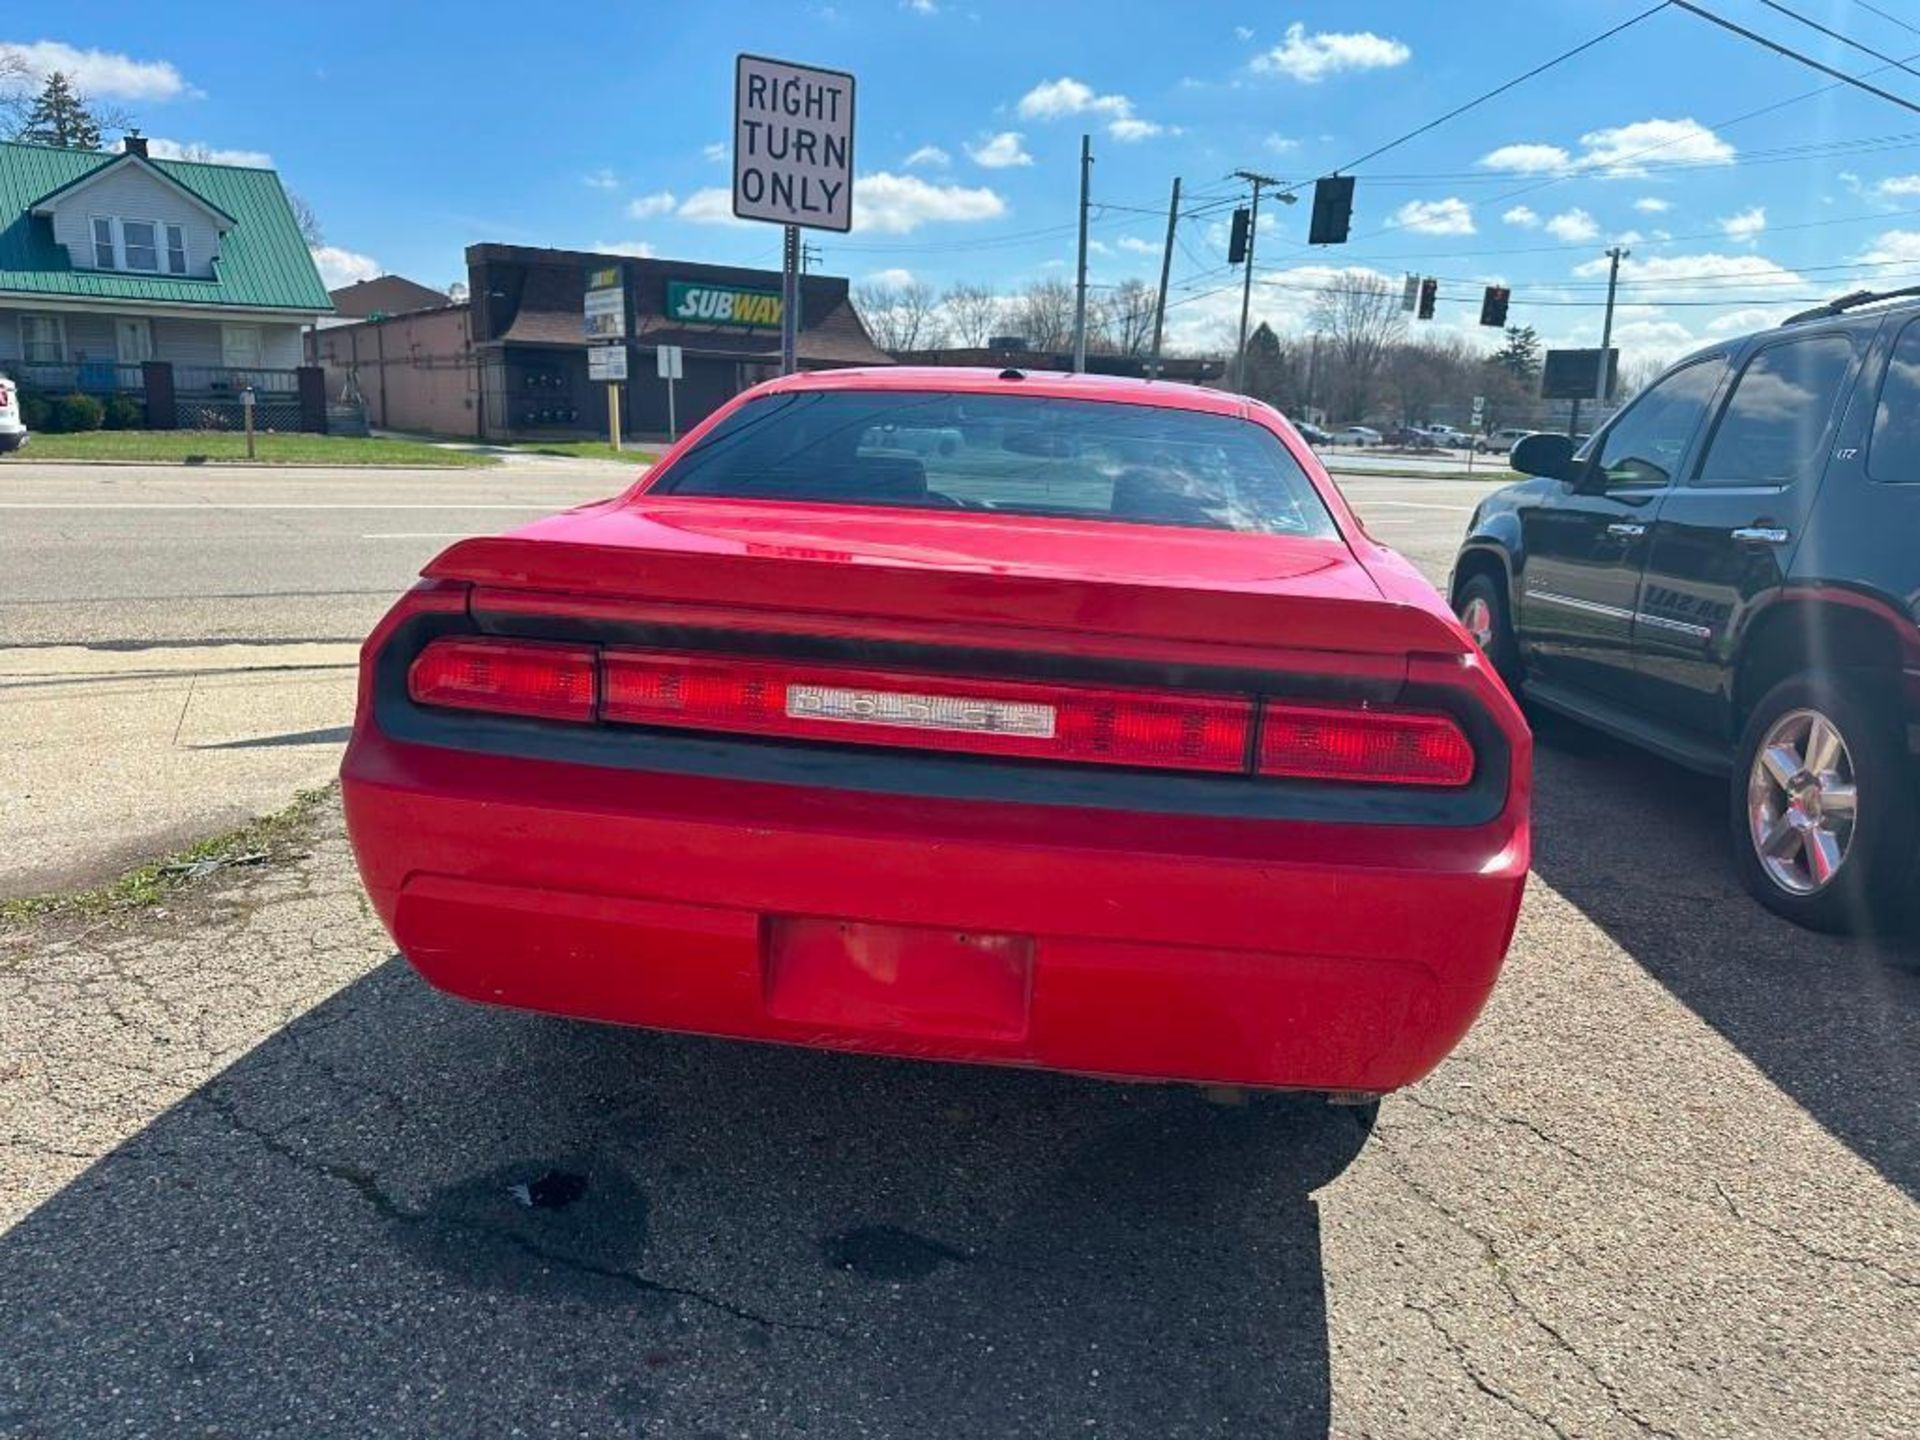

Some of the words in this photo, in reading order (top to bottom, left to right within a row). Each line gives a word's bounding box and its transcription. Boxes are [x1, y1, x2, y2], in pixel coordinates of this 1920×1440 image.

[748, 74, 842, 122] RIGHT
[743, 120, 846, 169] TURN
[742, 168, 842, 214] ONLY
[676, 288, 784, 323] SUBWAY
